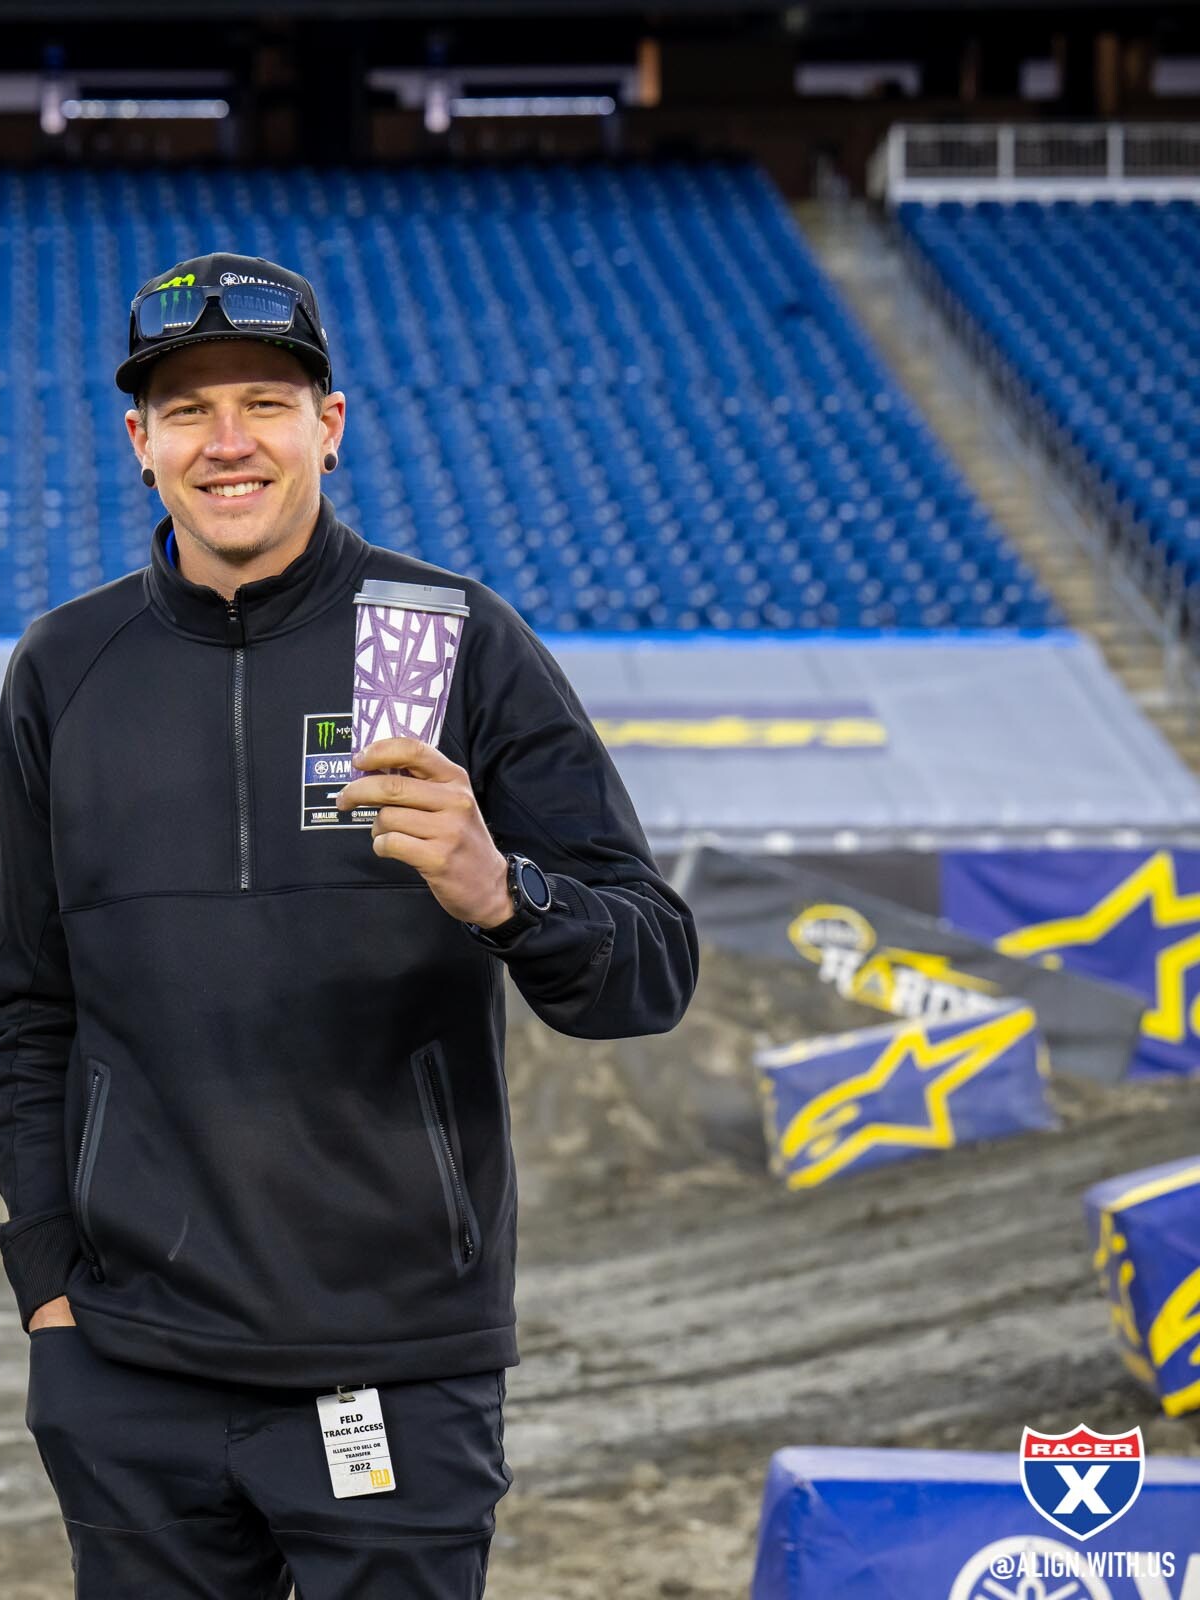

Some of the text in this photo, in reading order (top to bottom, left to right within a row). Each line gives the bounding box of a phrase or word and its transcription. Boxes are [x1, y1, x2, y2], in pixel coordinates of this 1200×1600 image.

[329, 760, 352, 774] YAM
[340, 1414, 363, 1425] FELD
[324, 1423, 384, 1438] TRACK ACCESS
[333, 1446, 352, 1454] ILLEGAL
[345, 1451, 371, 1459] TRANSFER
[349, 1462, 371, 1472] 2022
